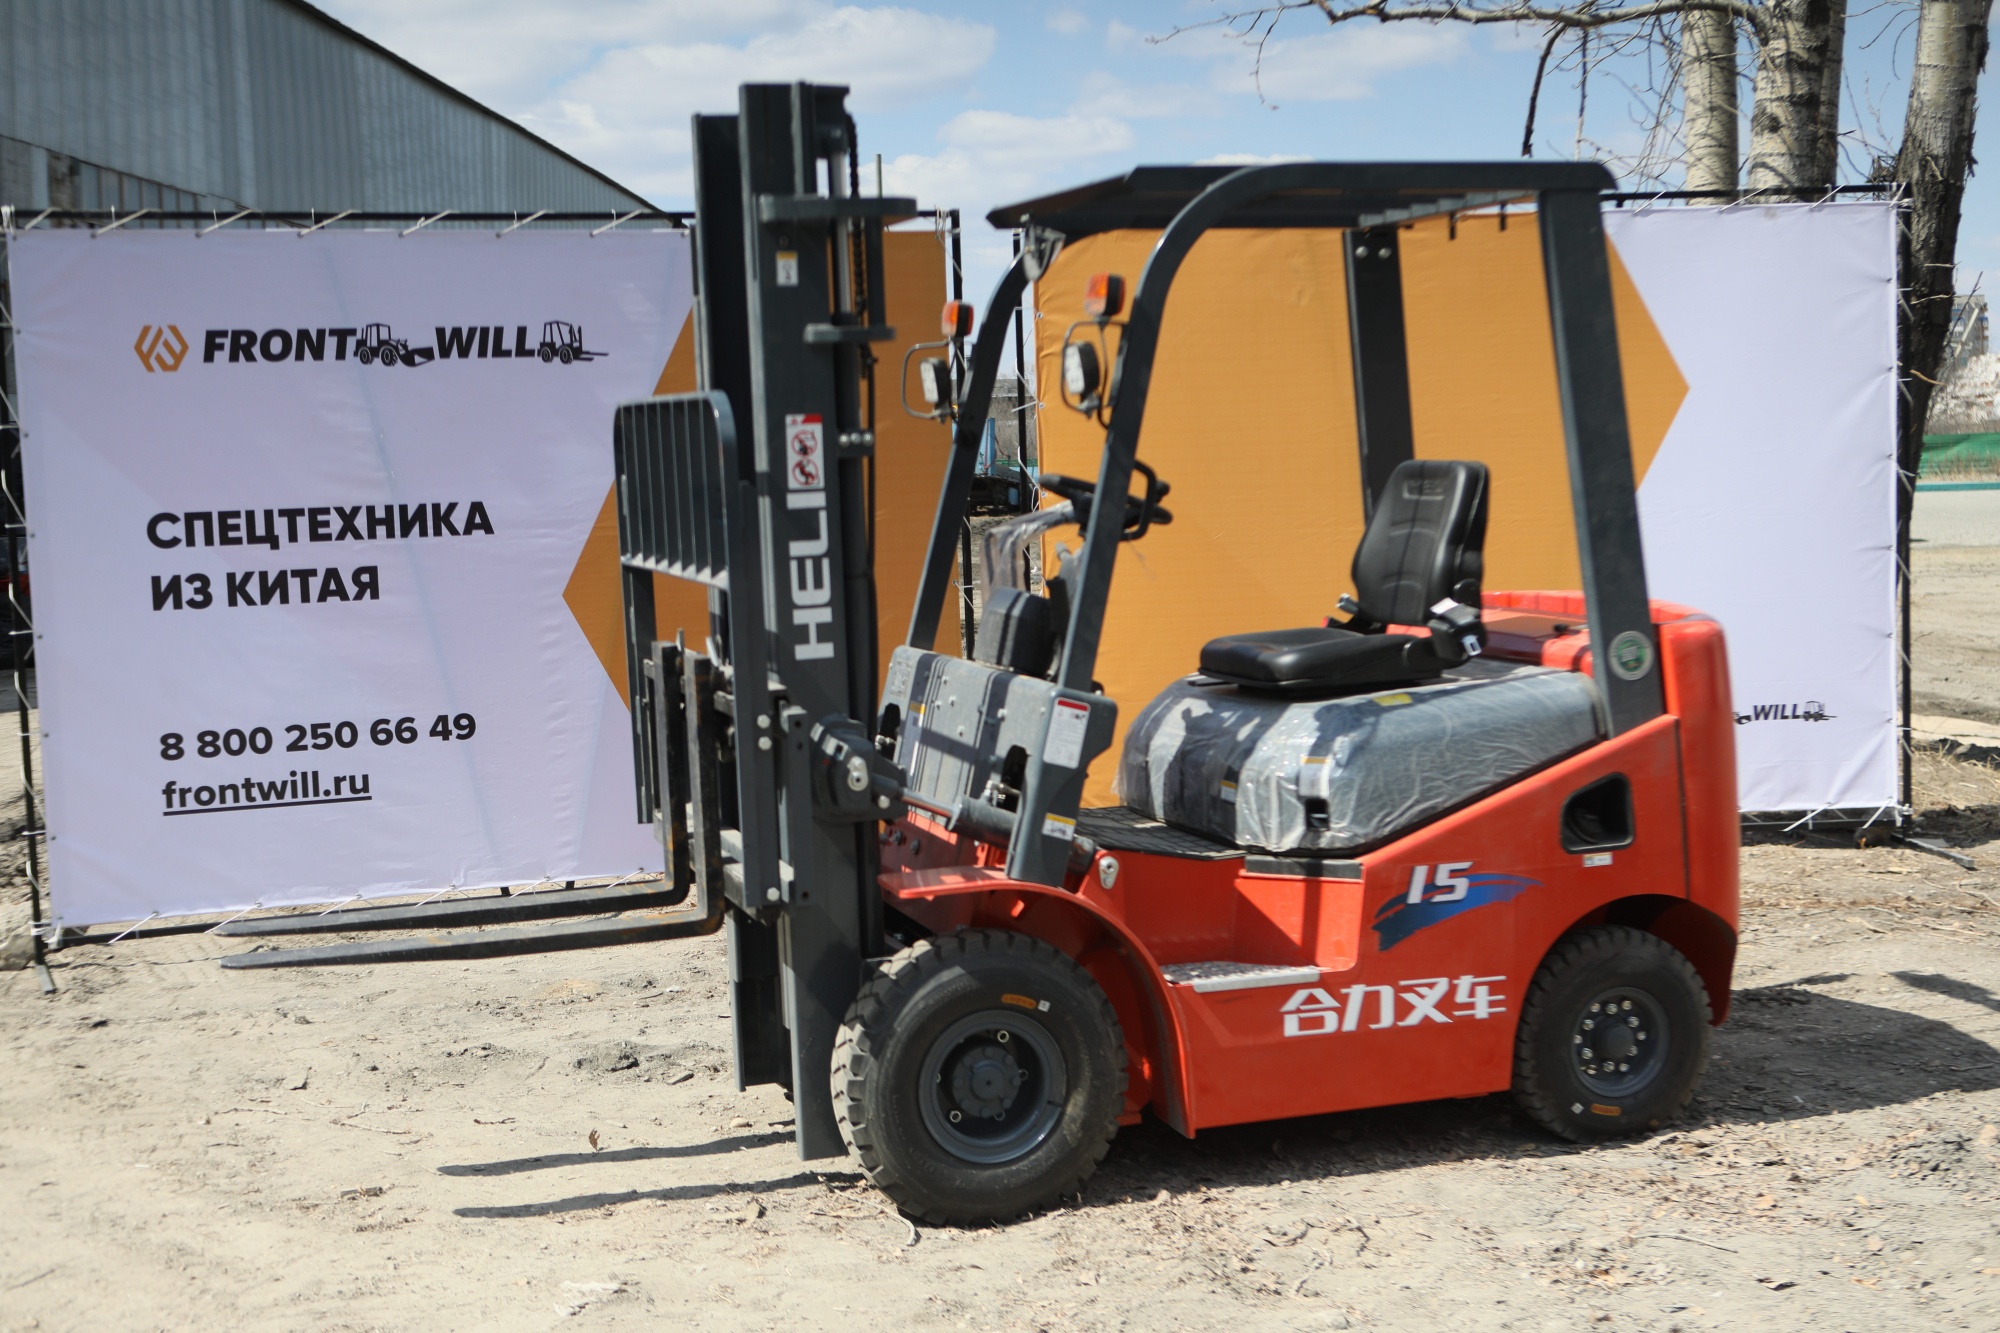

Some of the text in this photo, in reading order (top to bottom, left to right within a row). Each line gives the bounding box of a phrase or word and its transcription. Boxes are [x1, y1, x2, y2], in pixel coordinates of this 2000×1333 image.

[203, 325, 536, 363] FRONT WILL
[146, 501, 495, 550] СПЕЦТЕХНИКА
[151, 565, 380, 611] ИЗ КИТАЯ
[786, 490, 835, 661] HELI
[1753, 703, 1801, 721] WILL
[160, 712, 477, 761] 8 800 250 66 49
[162, 770, 371, 809] frontwill.ru
[1406, 861, 1474, 904] 15
[1279, 975, 1507, 1037] 合力叉车
